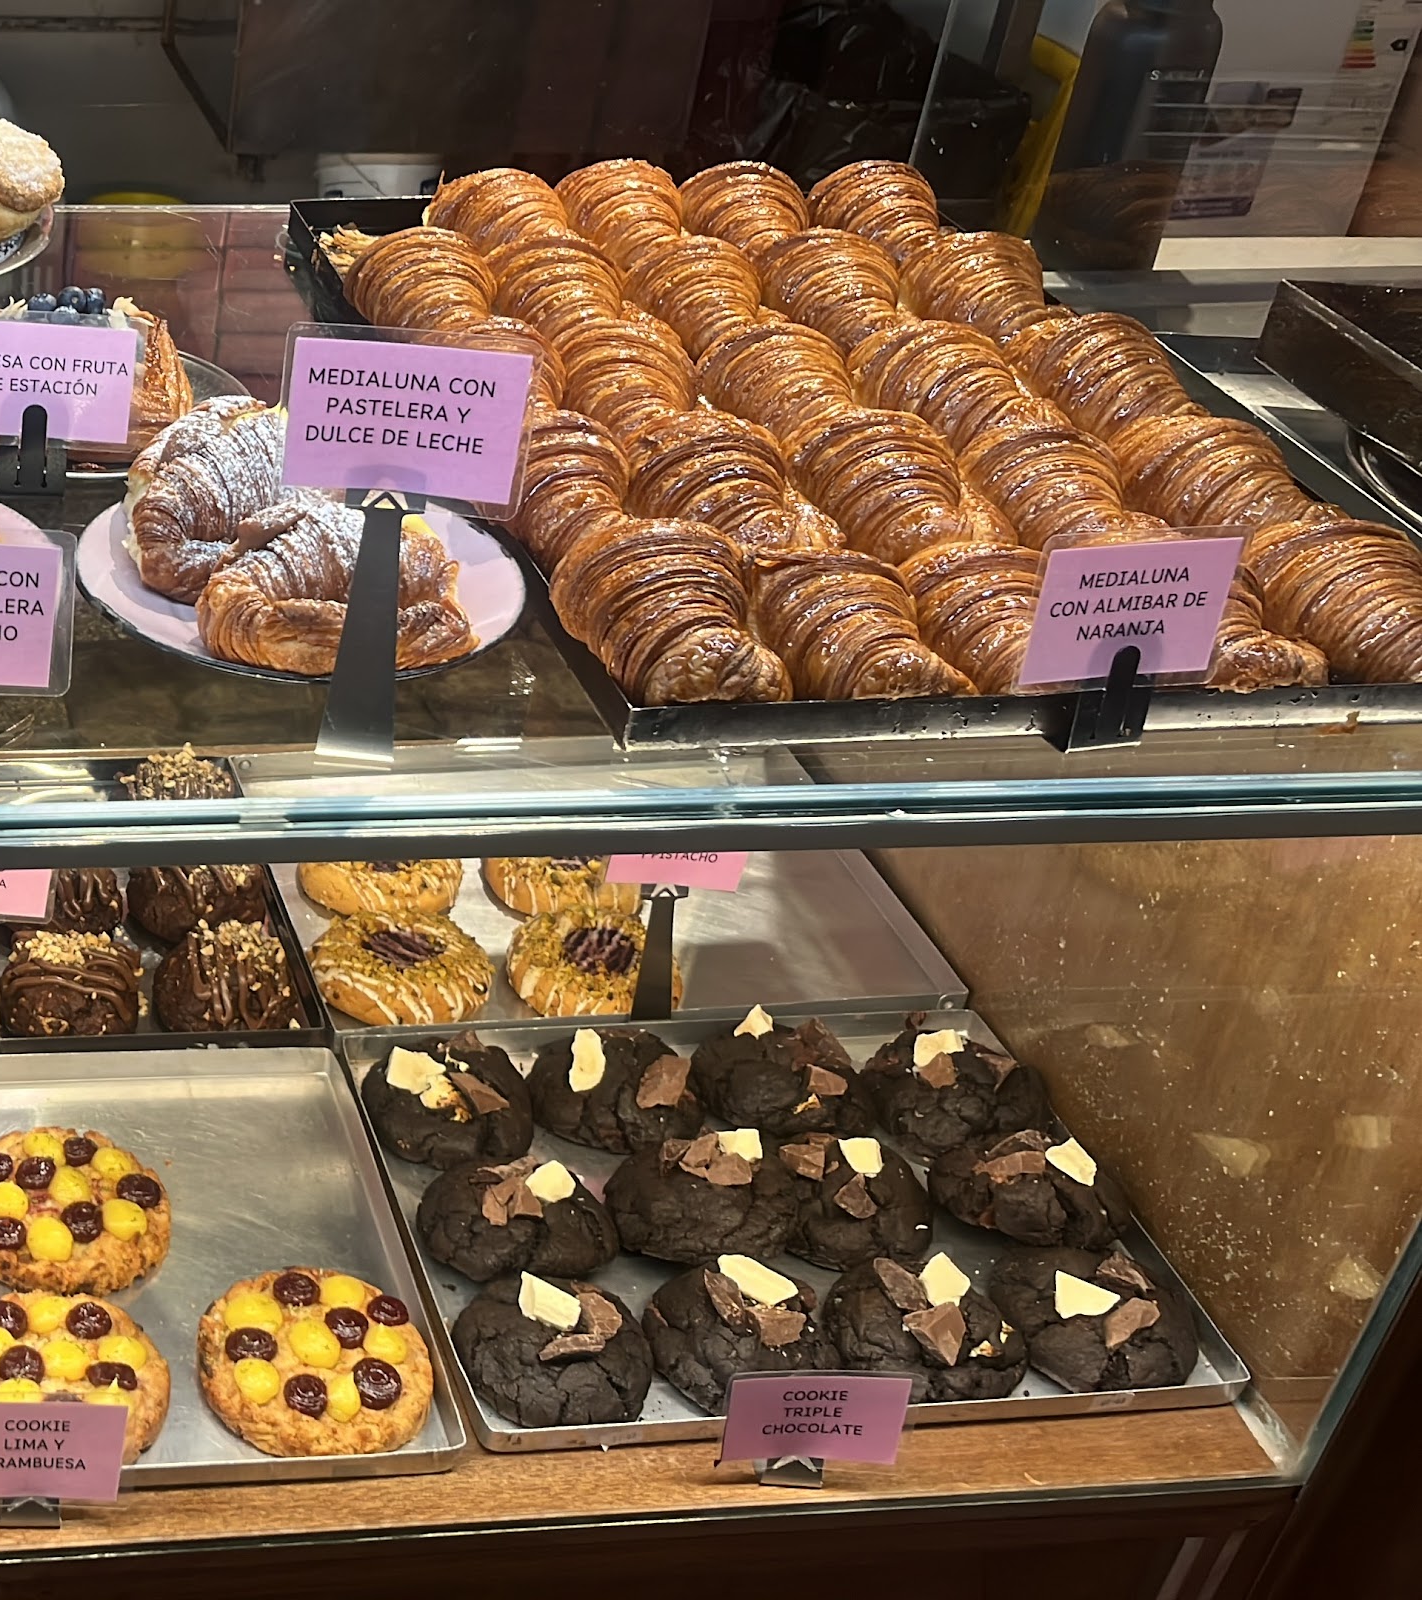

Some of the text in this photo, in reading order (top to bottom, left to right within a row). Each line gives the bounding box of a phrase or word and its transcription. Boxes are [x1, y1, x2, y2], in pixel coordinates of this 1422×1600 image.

[29, 356, 66, 371] CON
[72, 359, 128, 376] FRUTA
[10, 379, 98, 396] ESTACIÓN
[308, 367, 496, 398] MEDIALUNA CON
[326, 397, 471, 424] PASTELERA Y
[305, 425, 484, 454] DULCE DE LECHE
[1079, 566, 1190, 590] MEDIALUNA
[1050, 592, 1208, 618] CON ALMIBAR DE
[1076, 620, 1165, 641] NARANJA
[783, 1390, 849, 1401] COOKIE
[784, 1407, 842, 1418] TRIPLE
[4, 1420, 71, 1432] COOKIE
[762, 1423, 863, 1436] CHOCOLATE
[4, 1438, 65, 1450] LIMA Y
